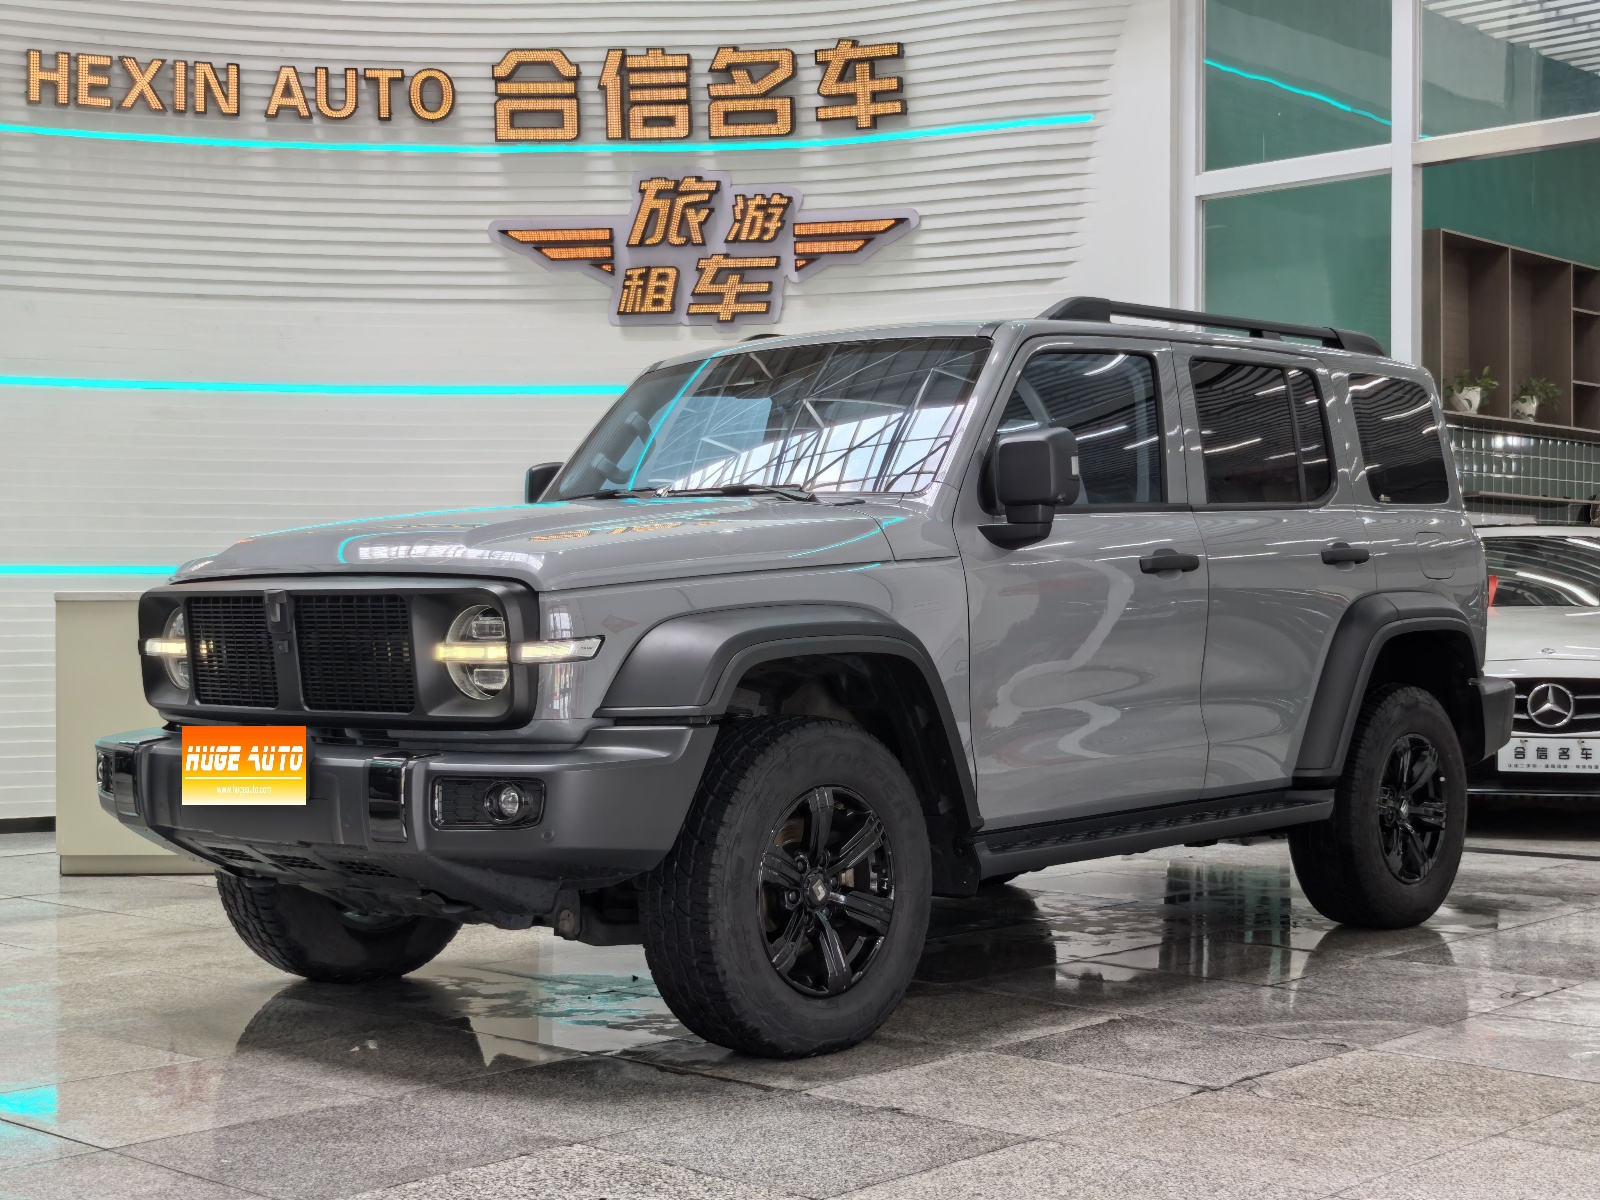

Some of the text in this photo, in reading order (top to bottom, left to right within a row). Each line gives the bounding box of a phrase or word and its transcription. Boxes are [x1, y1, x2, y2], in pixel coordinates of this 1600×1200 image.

[26, 49, 456, 122] HEXIN AUTO
[491, 39, 907, 142] 合信名车
[626, 176, 793, 247] 旅游
[617, 254, 781, 323] 租车
[1514, 746, 1592, 760] 合信名车
